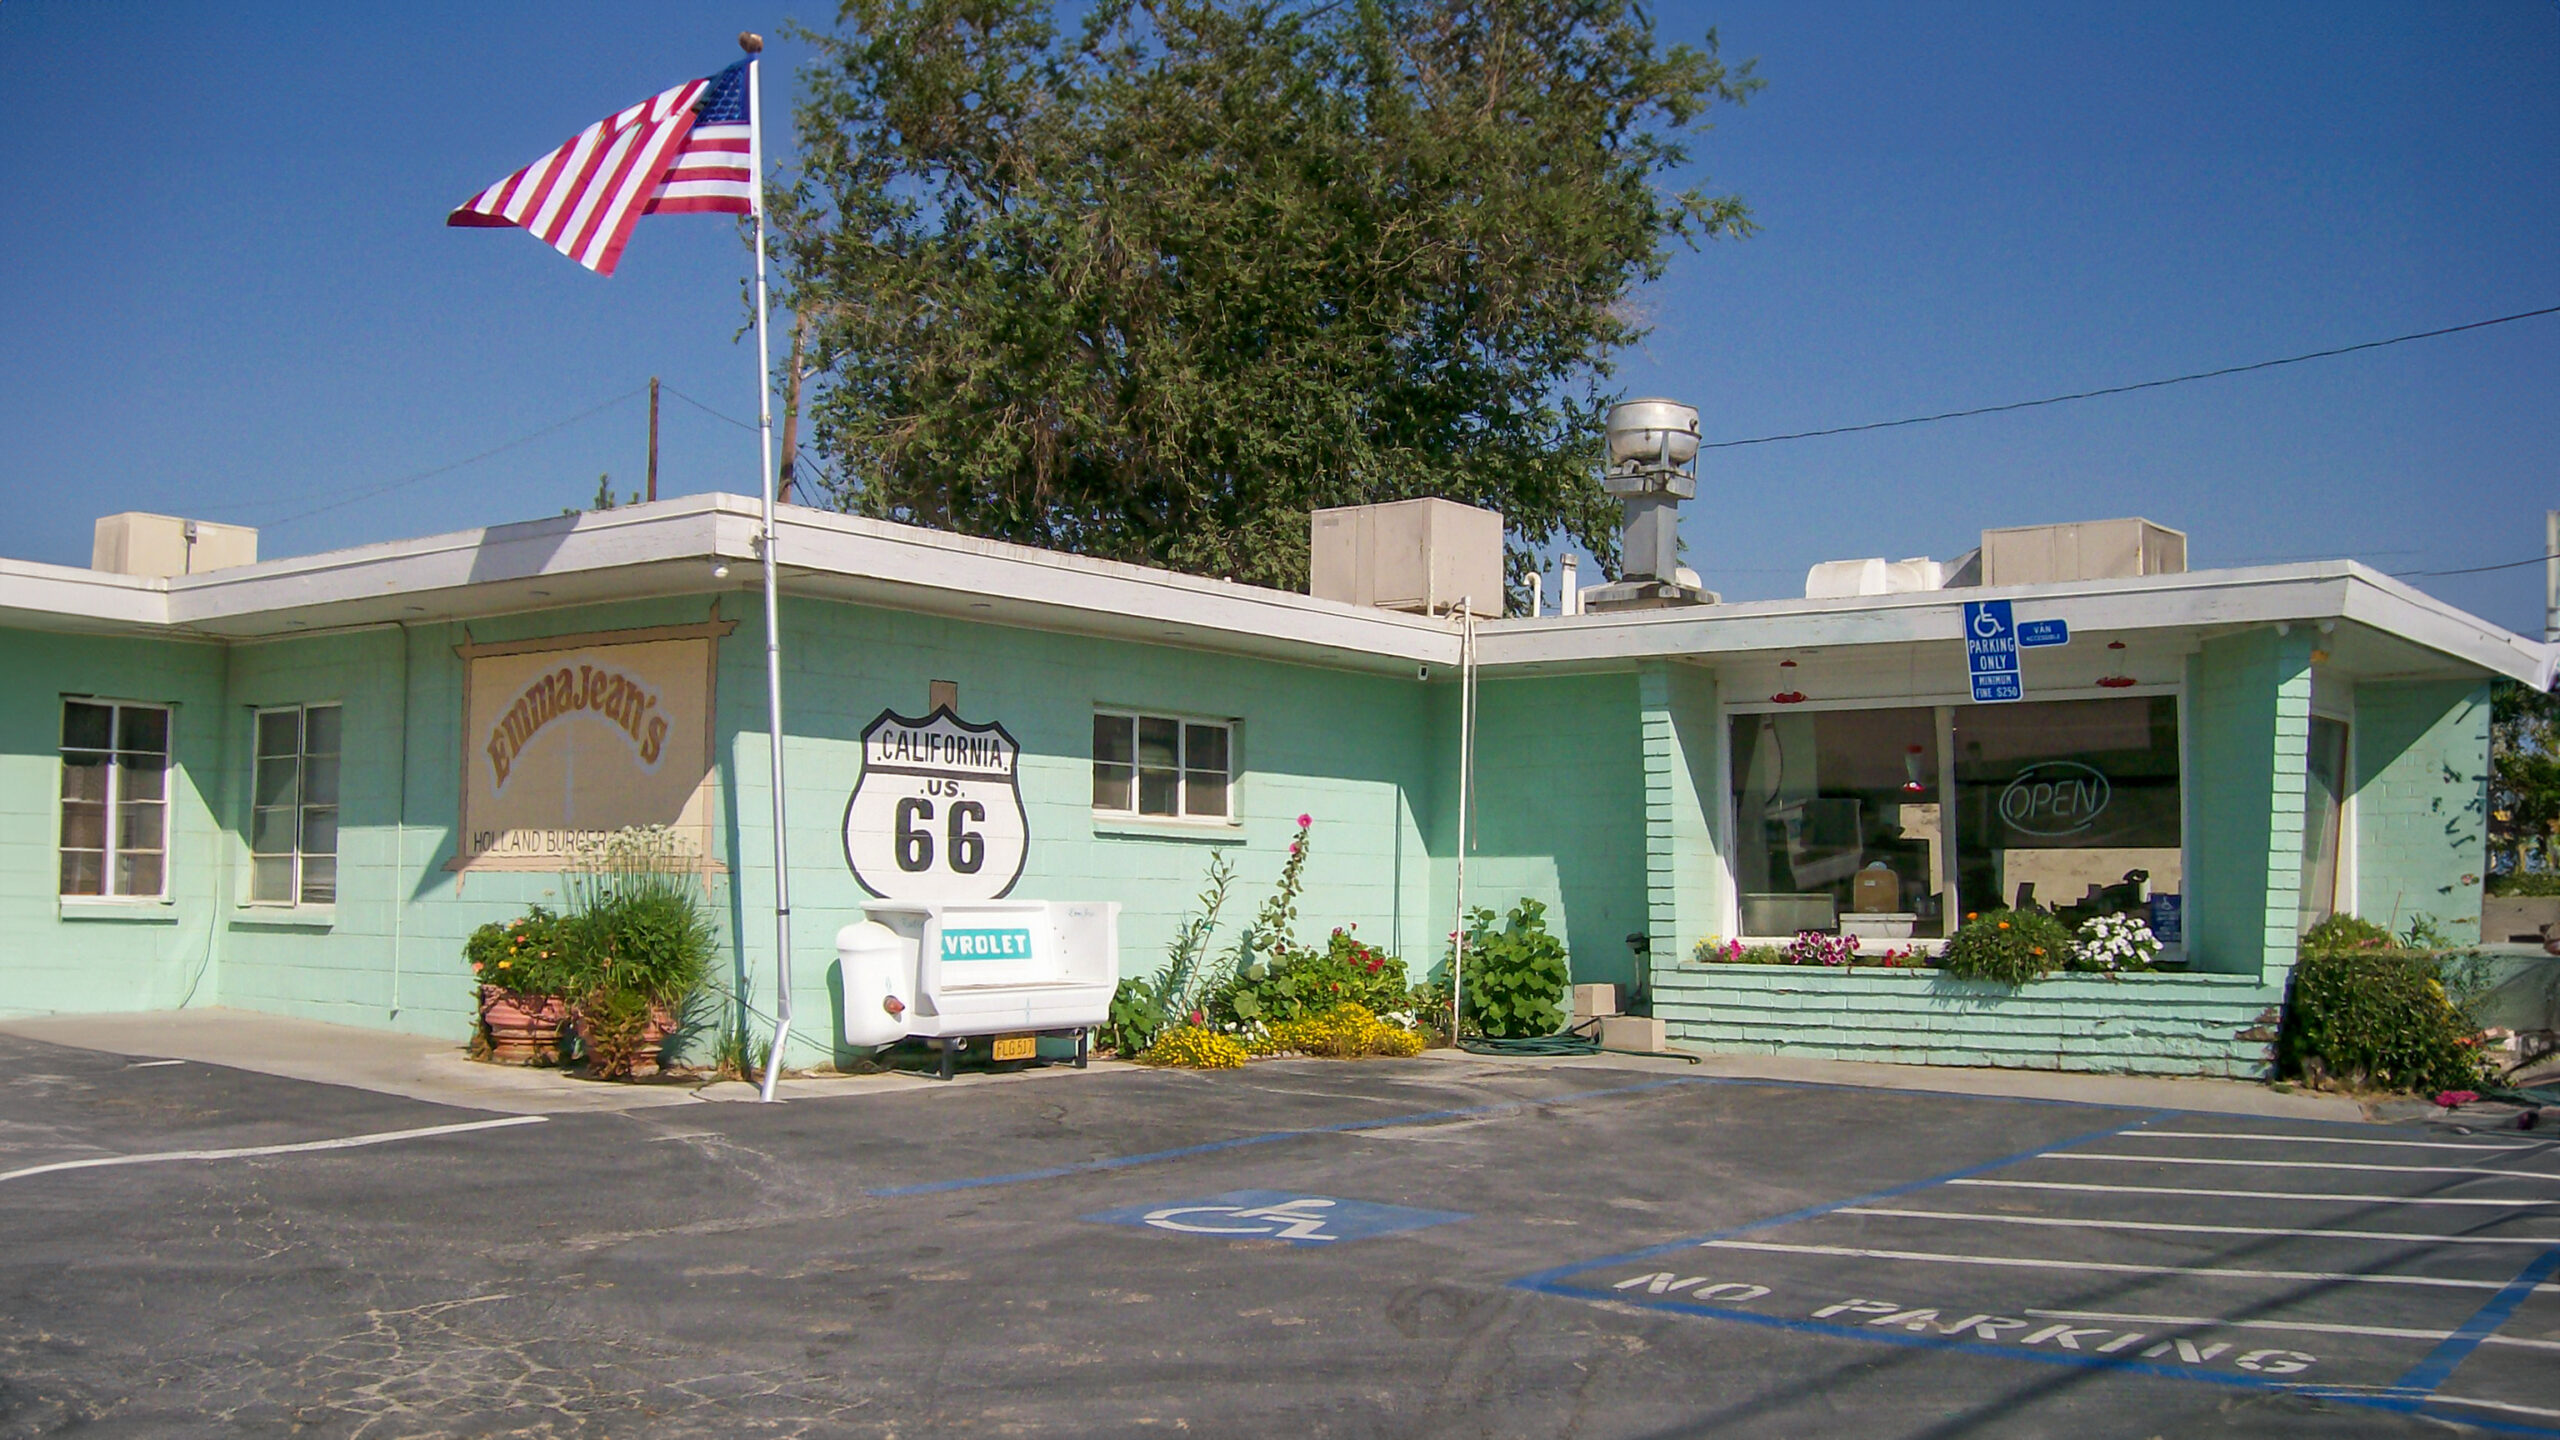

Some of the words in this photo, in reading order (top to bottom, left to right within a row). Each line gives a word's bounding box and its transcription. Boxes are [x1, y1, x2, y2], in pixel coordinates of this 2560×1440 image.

[2033, 624, 2052, 634] VAN
[1969, 637, 2015, 654] PARKING
[1980, 655, 2007, 670] ONLY
[1979, 675, 2012, 686] MINIMUM
[1975, 687, 1993, 698] FINE
[1996, 686, 2018, 697] $250
[880, 729, 1003, 768] CALIFORNIA
[2004, 779, 2099, 819] OPEN
[474, 831, 541, 852] HOLLAND
[547, 829, 608, 852] BURGER
[895, 797, 985, 874] 66
[941, 934, 1027, 955] VROLET
[1612, 1272, 1773, 1302] NO
[1811, 1298, 2317, 1374] PARKING
